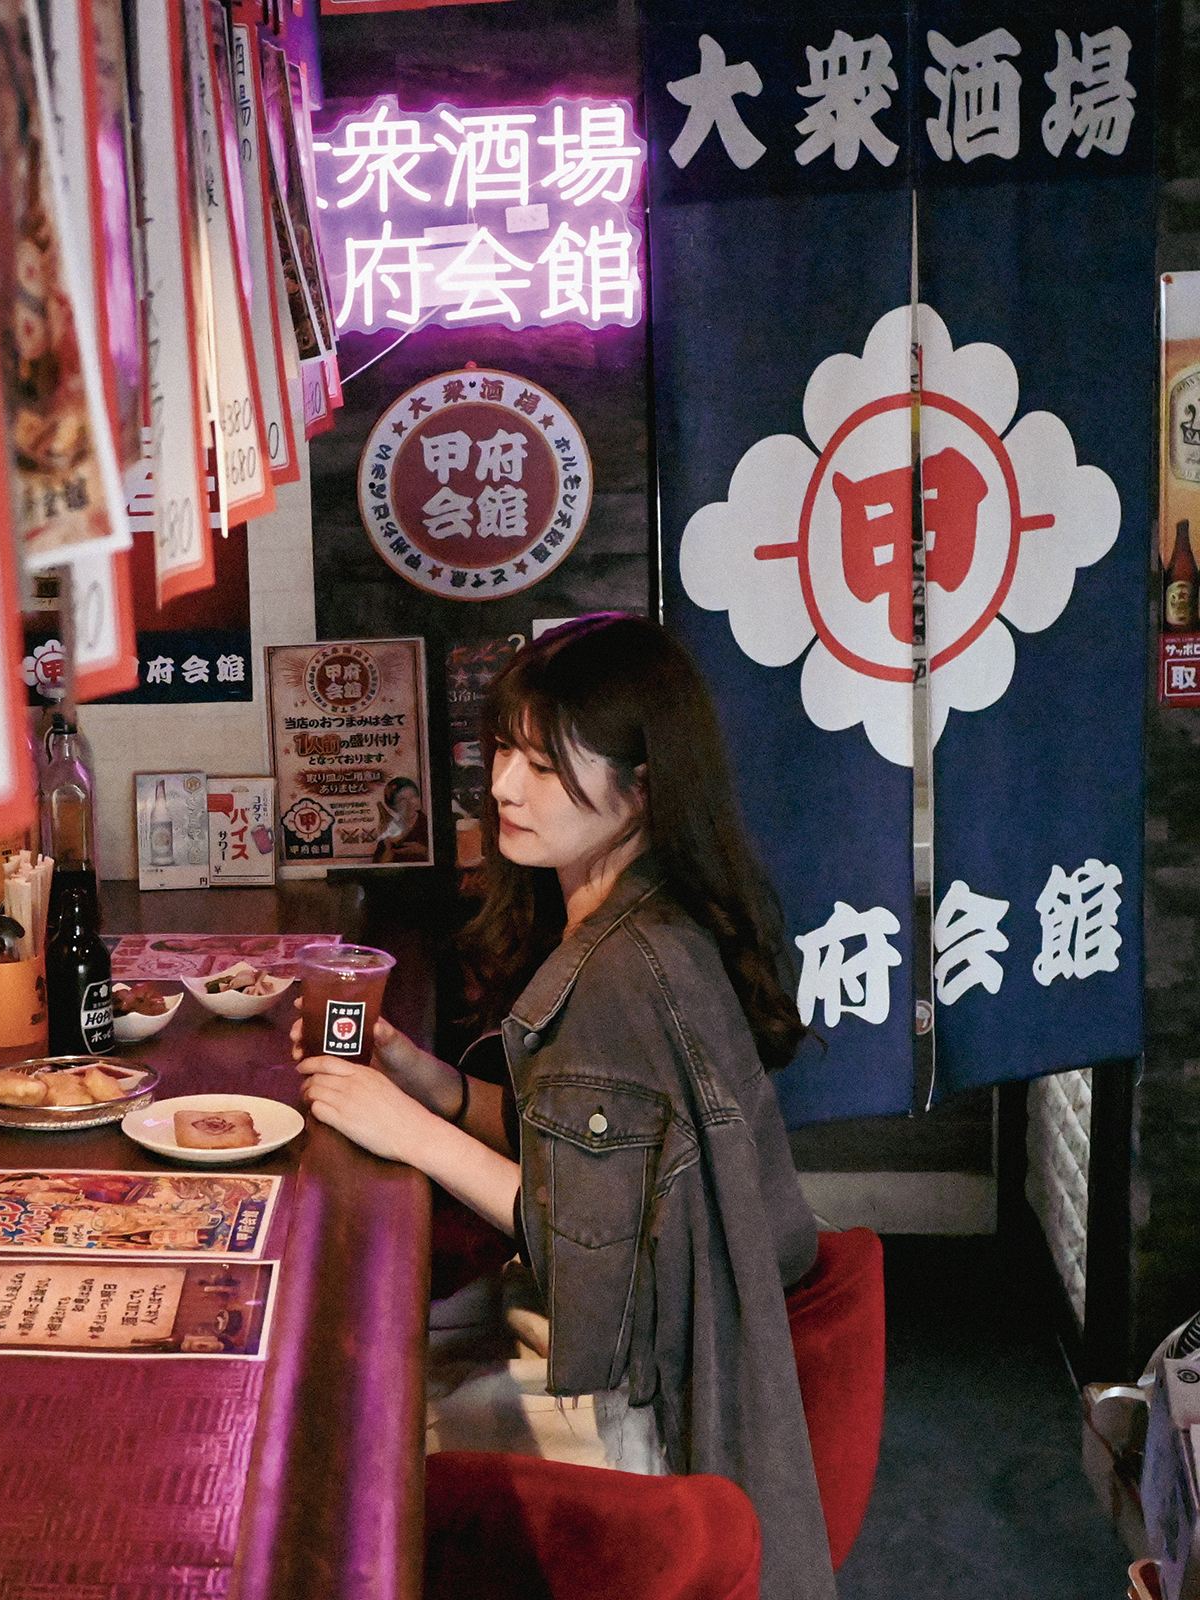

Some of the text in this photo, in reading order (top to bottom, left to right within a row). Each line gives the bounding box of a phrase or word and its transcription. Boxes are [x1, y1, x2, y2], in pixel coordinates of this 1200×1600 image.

[667, 26, 1137, 170] 大衆酒場
[313, 106, 641, 212] 衆酒場
[335, 220, 633, 326] 府会館
[408, 378, 542, 420] 大衆酒場
[420, 429, 528, 484] 甲府
[421, 484, 529, 540] 会館
[832, 447, 990, 645] 甲
[146, 654, 246, 684] 府会館
[1171, 665, 1197, 689] 取
[285, 714, 406, 730] 当店のおつまみは全て
[293, 733, 400, 757] 1人前の盛り付け
[253, 796, 262, 822] コダマ
[319, 783, 370, 795] ありません
[218, 831, 228, 860] サワー
[230, 808, 250, 860] バイス
[795, 858, 1123, 1028] 府会館
[337, 1021, 354, 1037] 甲
[8, 1203, 58, 1243] ハイボール
[234, 1210, 259, 1240] 甲府会館
[86, 1283, 118, 1332] 答えはいつも明日
[120, 1288, 145, 1325] 酒こぼしても
[140, 1284, 166, 1324] 人はこぼすな
